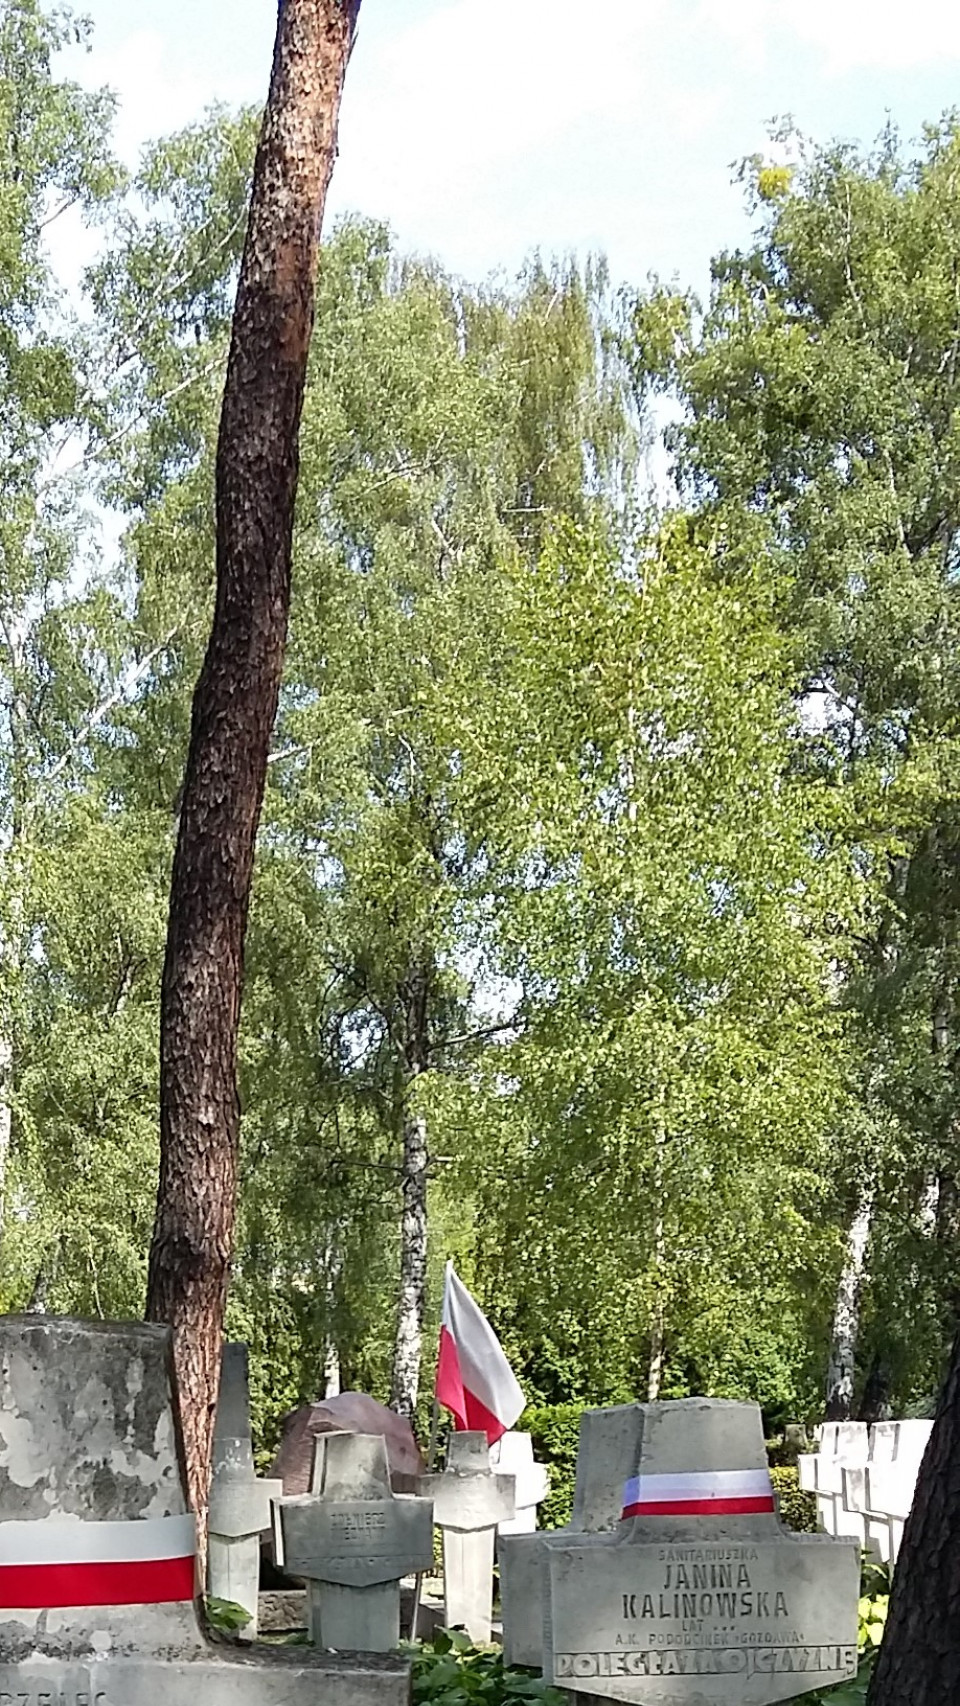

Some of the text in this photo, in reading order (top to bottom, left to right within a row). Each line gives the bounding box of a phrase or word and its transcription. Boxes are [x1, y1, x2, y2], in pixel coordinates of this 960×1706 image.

[664, 1564, 751, 1589] JANINA
[623, 1592, 789, 1619] KALINOWSKA
[682, 1619, 704, 1631] LAT
